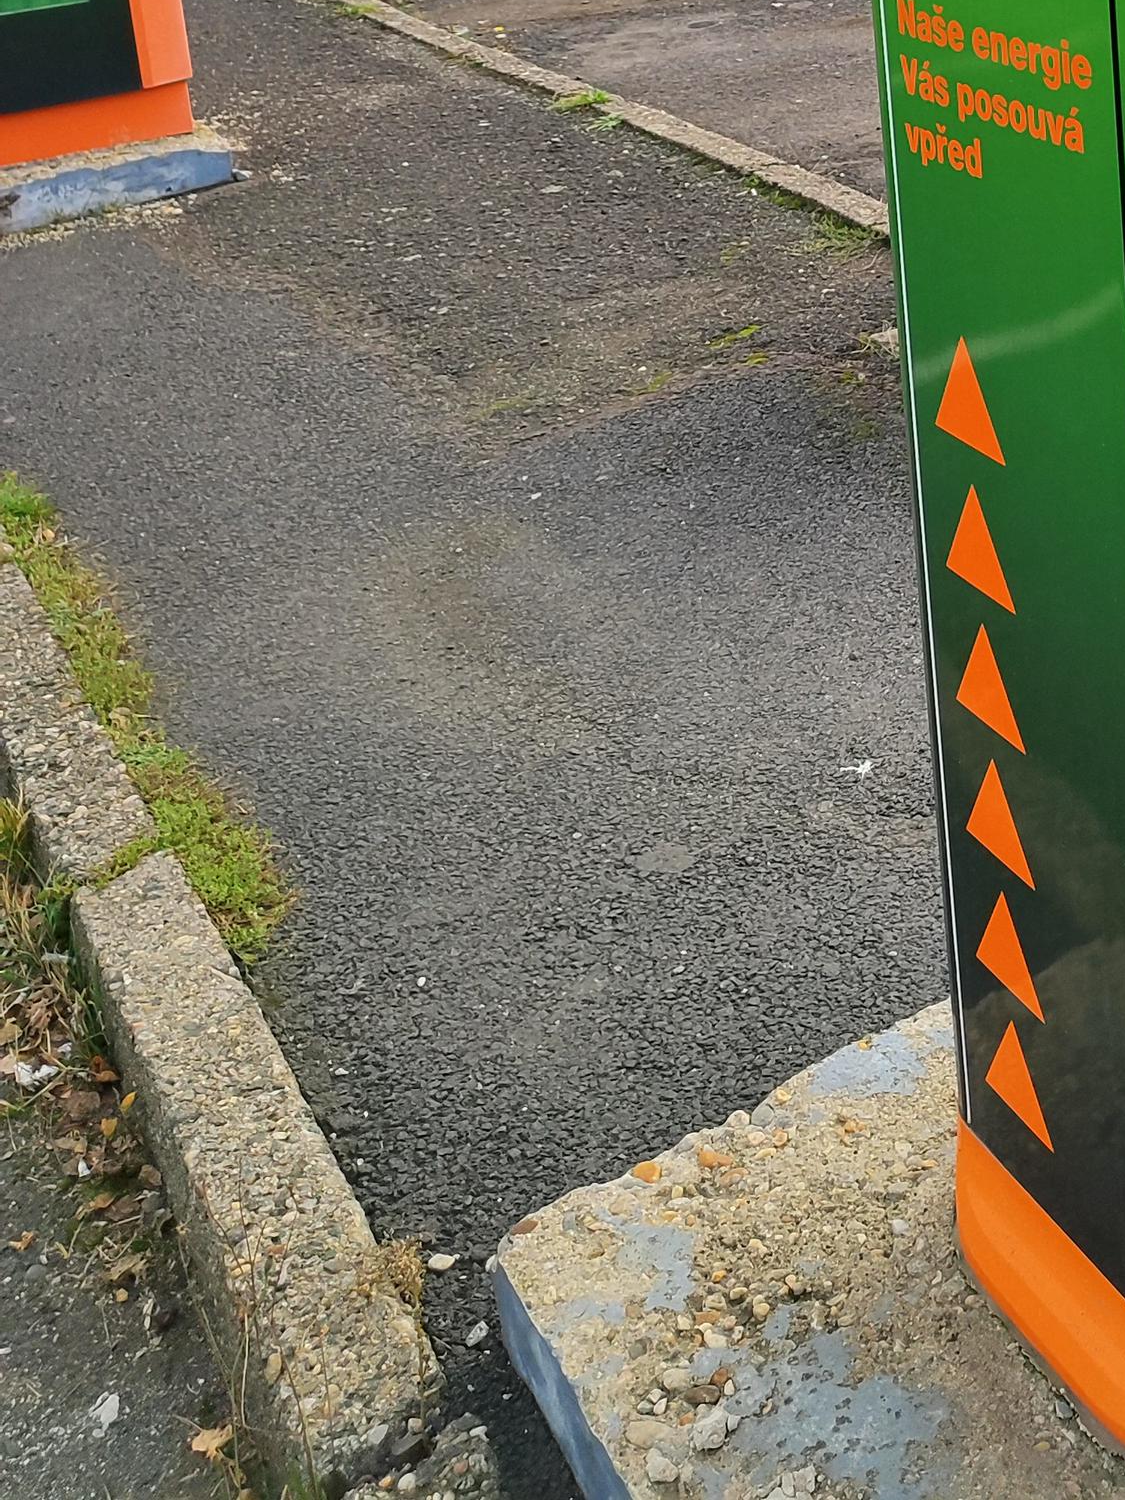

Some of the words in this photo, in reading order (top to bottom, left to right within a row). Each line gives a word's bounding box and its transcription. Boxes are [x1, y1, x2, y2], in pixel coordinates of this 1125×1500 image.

[972, 26, 1093, 90] energie
[900, 54, 950, 107] Vás
[956, 82, 1085, 154] posouvá
[904, 123, 983, 179] vpřed
